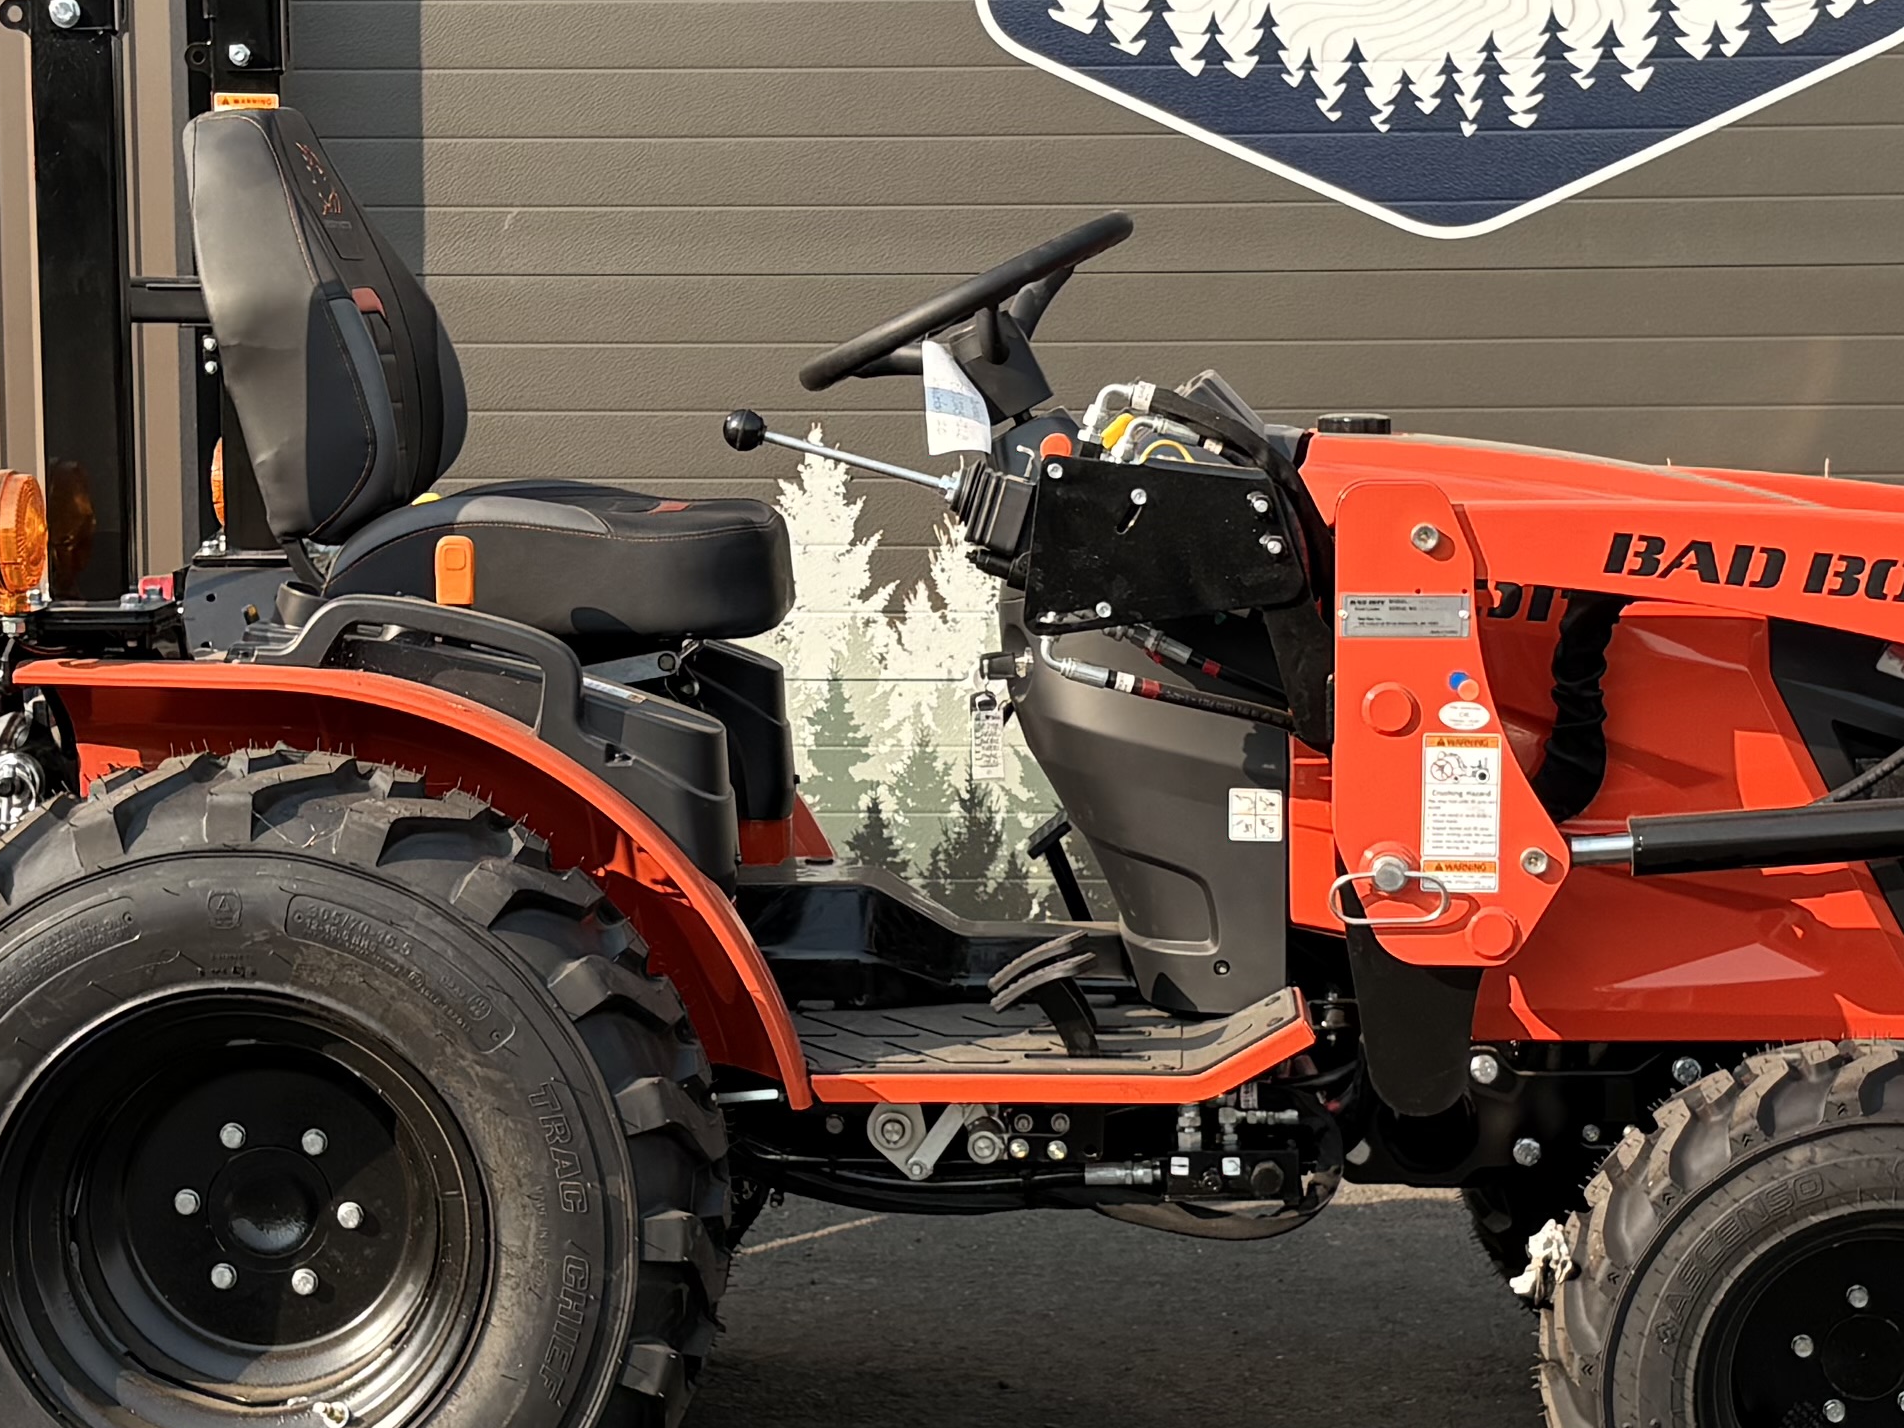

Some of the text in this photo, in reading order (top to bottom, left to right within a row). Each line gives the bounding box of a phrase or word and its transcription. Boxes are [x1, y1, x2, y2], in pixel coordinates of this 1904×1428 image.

[1603, 532, 1787, 590] BAD
[1445, 863, 1487, 873] WARNING
[528, 1081, 591, 1402] TRAC CHIEF
[1663, 1169, 1826, 1324] ASCENSO
